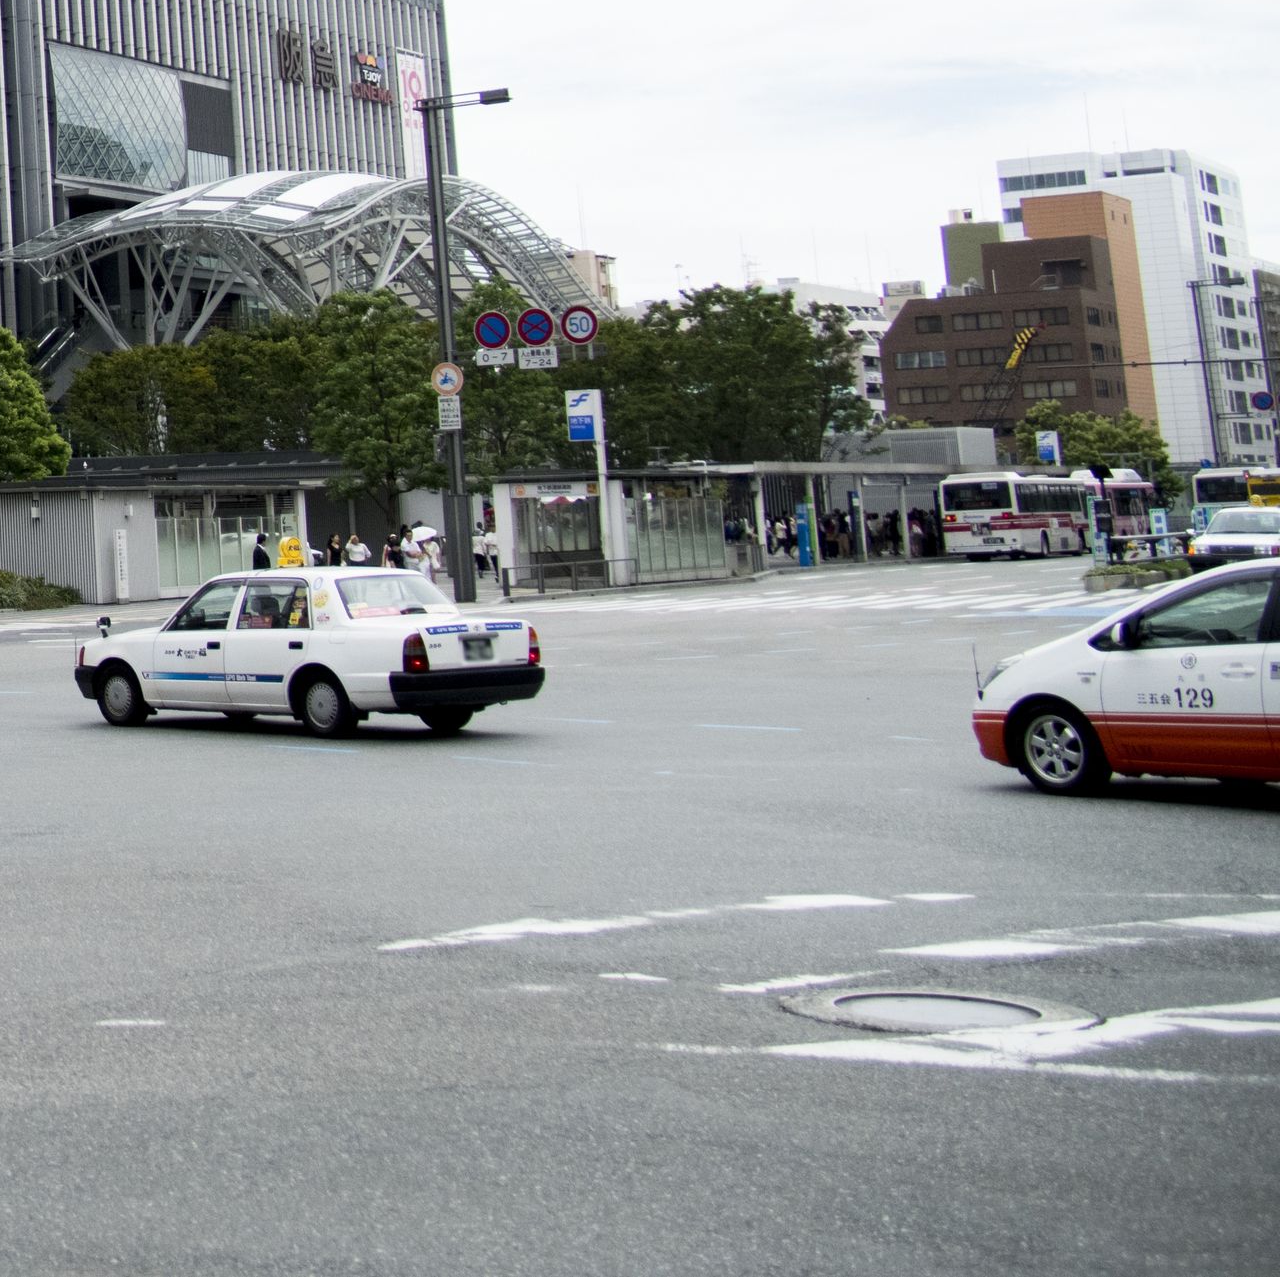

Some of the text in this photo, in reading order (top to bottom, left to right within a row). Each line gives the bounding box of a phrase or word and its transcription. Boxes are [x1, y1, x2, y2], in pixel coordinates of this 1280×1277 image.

[276, 28, 339, 91] 阪急
[351, 82, 394, 107] CINEMA
[568, 316, 590, 334] 50
[482, 352, 508, 363] 0-7
[525, 359, 552, 367] 7-24
[1137, 687, 1214, 709] 三五会 129
